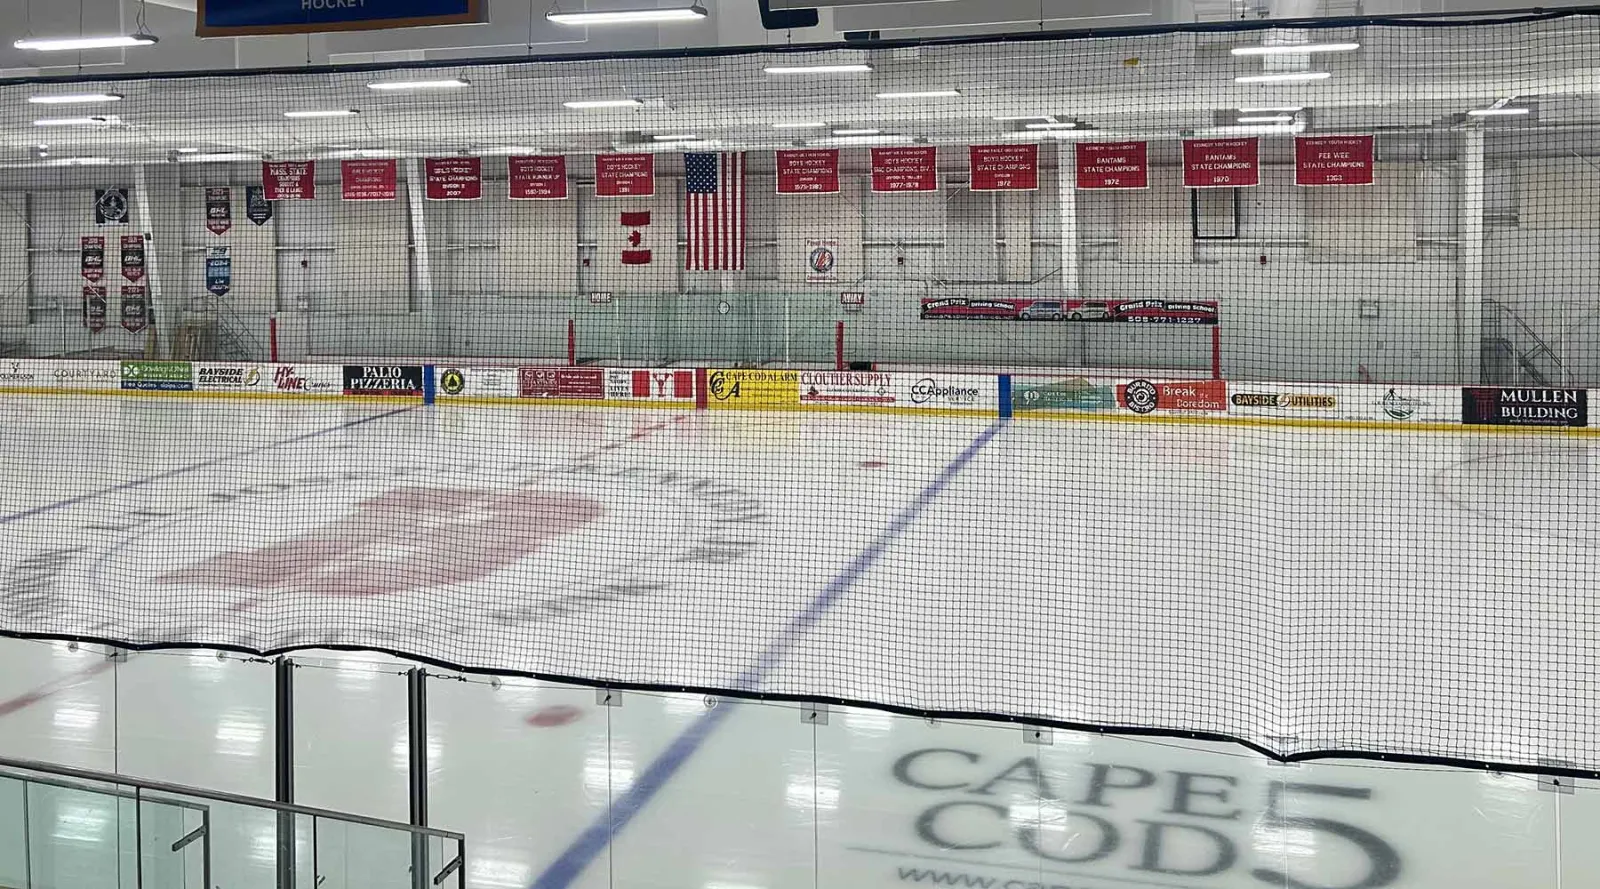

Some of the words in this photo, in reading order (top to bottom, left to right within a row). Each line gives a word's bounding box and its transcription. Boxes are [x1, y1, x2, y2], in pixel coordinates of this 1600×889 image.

[1120, 301, 1144, 311] Grand
[54, 369, 116, 378] COURTYARD
[199, 368, 244, 376] BAYSIDE
[363, 366, 402, 378] PALIO
[726, 372, 748, 380] CAPE
[749, 372, 766, 381] COD
[768, 372, 798, 382] ALARM
[199, 376, 242, 384] ELECTRICAL
[350, 378, 416, 390] PIZZERIA
[801, 372, 852, 386] CLOUTIER
[854, 373, 892, 386] SUPPLY
[1126, 382, 1156, 395] BURRITO
[1162, 386, 1196, 396] Break
[1236, 394, 1275, 405] BAYSIDE
[1292, 396, 1333, 406] UTILITIES
[1500, 390, 1577, 402] MULLEN
[1128, 401, 1155, 412] BISTRO
[1501, 406, 1578, 418] BUILDING
[892, 748, 1240, 821] CAPE
[915, 800, 1237, 877] COD
[1250, 780, 1403, 889] 5
